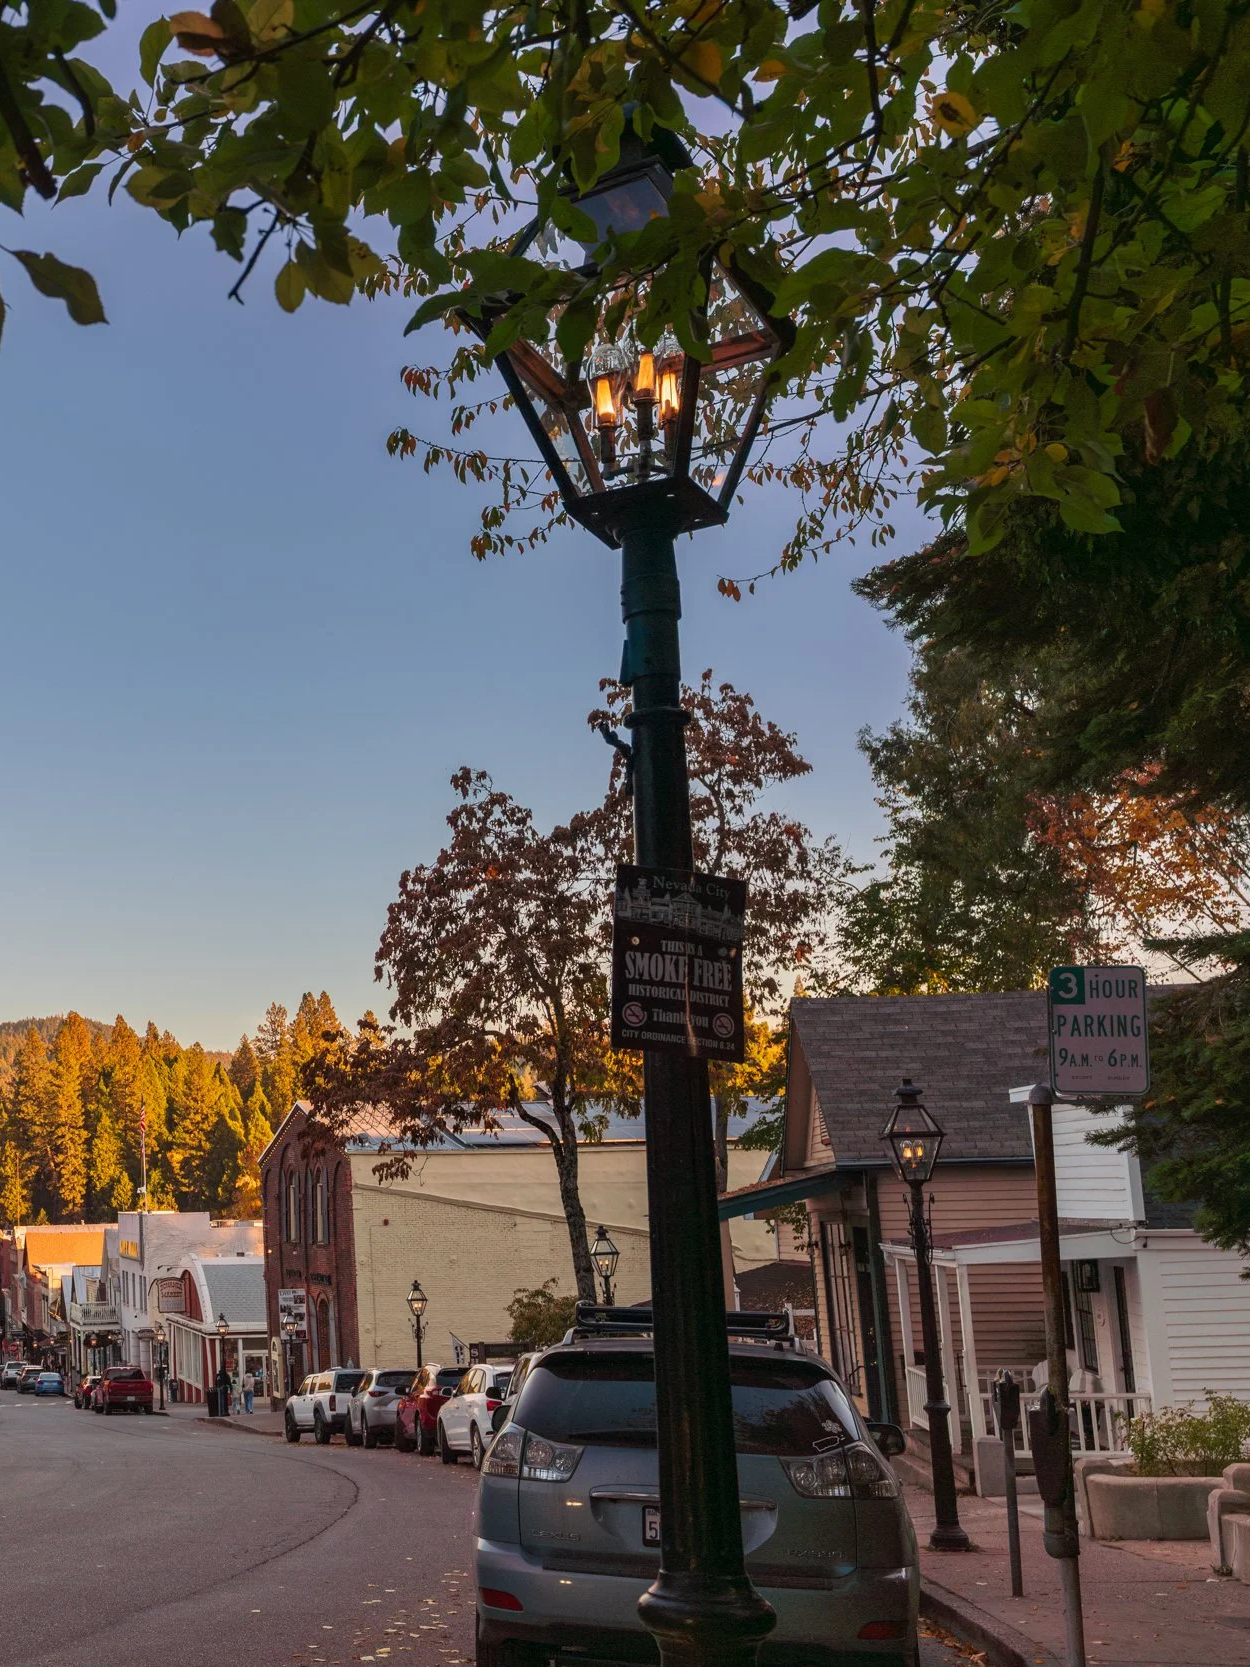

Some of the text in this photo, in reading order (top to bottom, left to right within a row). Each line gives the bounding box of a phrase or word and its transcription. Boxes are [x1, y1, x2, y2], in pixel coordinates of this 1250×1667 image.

[653, 876, 731, 900] Nevada City
[660, 940, 685, 953] THIS
[697, 945, 703, 956] A
[625, 951, 732, 991] SMOKE FREE
[628, 984, 729, 1007] HISTORICAL DISTRICT
[1058, 972, 1138, 999] 3 HOUR
[652, 1008, 709, 1028] Thank you
[1057, 1015, 1141, 1037] PARKING
[622, 1029, 638, 1038] CITY
[641, 1031, 686, 1043] ORDINANCE
